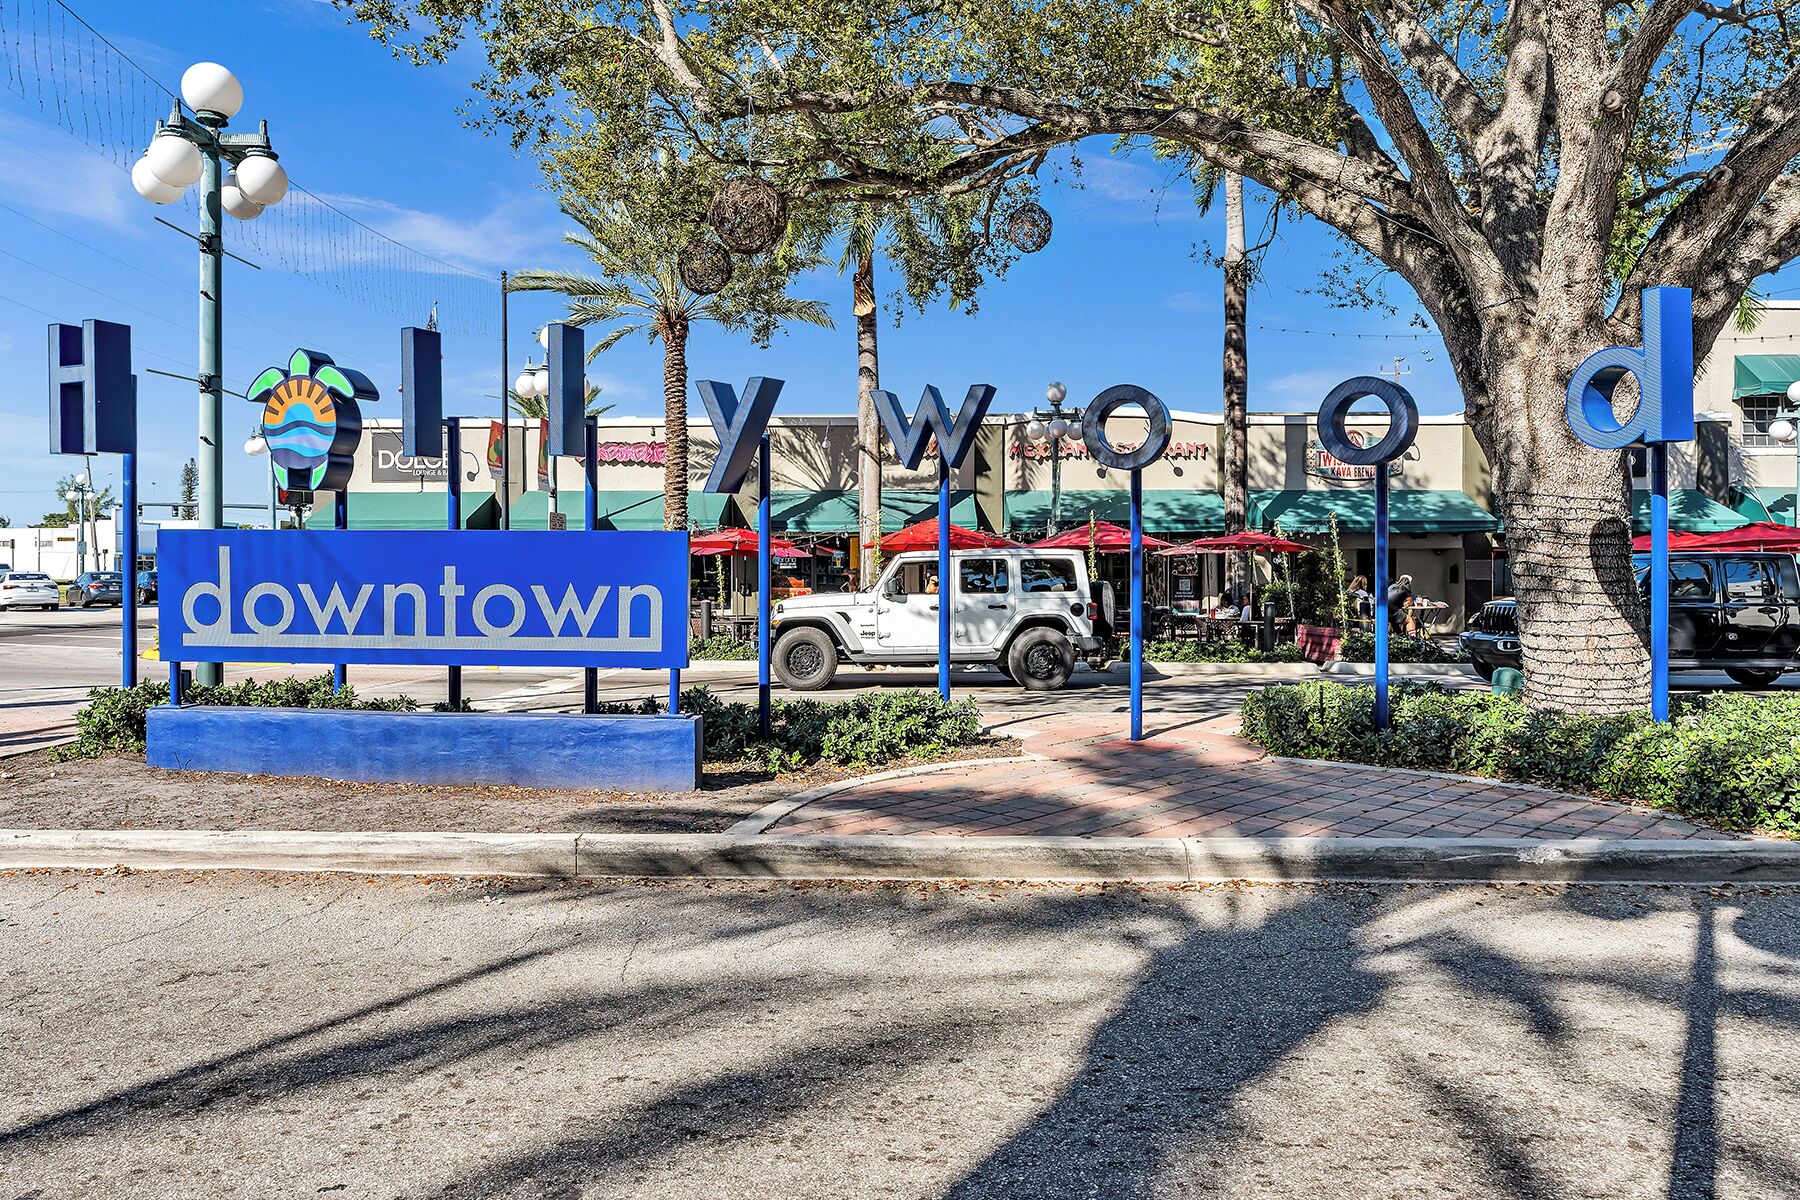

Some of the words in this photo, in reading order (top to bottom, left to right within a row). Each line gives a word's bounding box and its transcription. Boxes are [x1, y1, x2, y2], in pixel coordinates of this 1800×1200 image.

[48, 286, 1694, 494] Hllywood
[1331, 467, 1352, 477] KAVA
[183, 545, 663, 652] downtown
